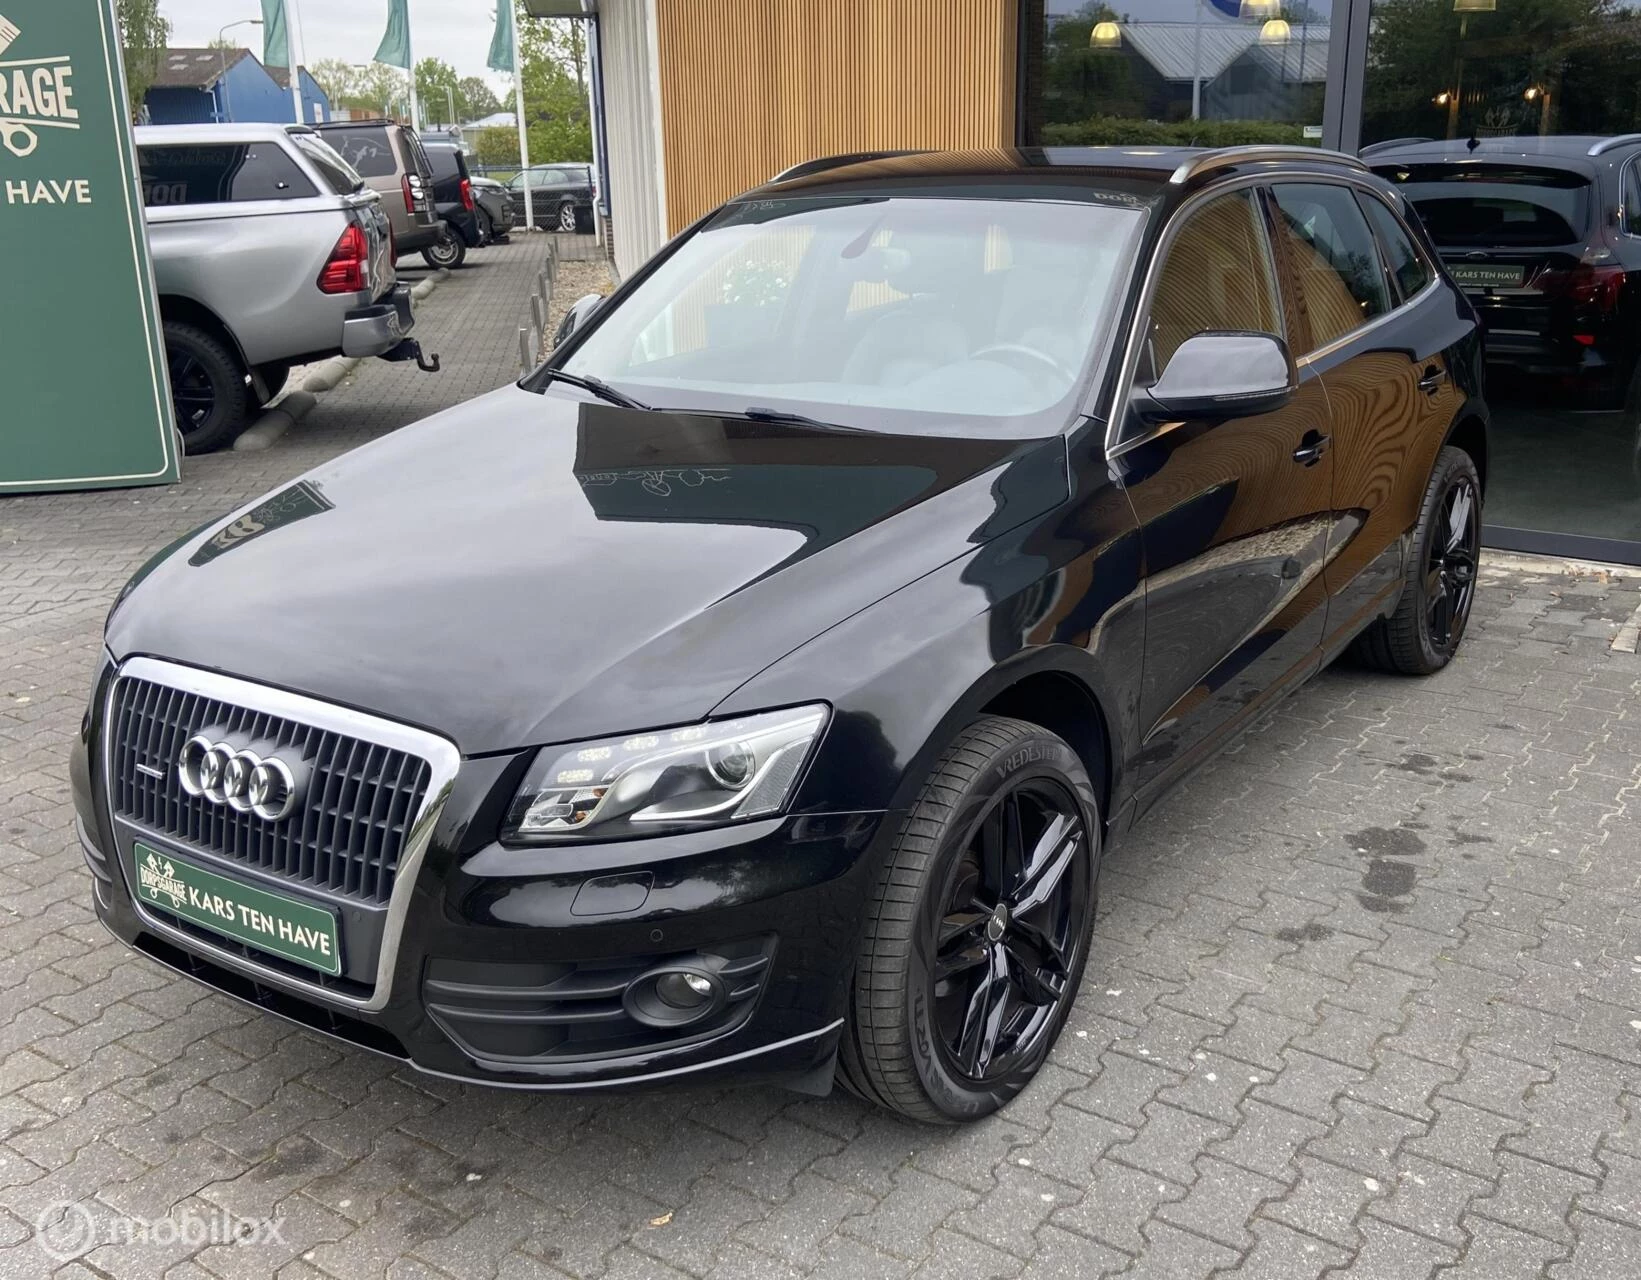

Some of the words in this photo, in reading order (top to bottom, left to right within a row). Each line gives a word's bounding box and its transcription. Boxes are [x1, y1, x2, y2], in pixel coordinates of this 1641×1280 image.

[6, 179, 92, 204] HAVE
[1455, 271, 1478, 279] KARS
[1480, 271, 1496, 279] TEN
[1497, 271, 1521, 280] HAVE
[188, 886, 235, 921] KARS
[238, 904, 275, 936] TEN
[278, 918, 331, 956] HAVE
